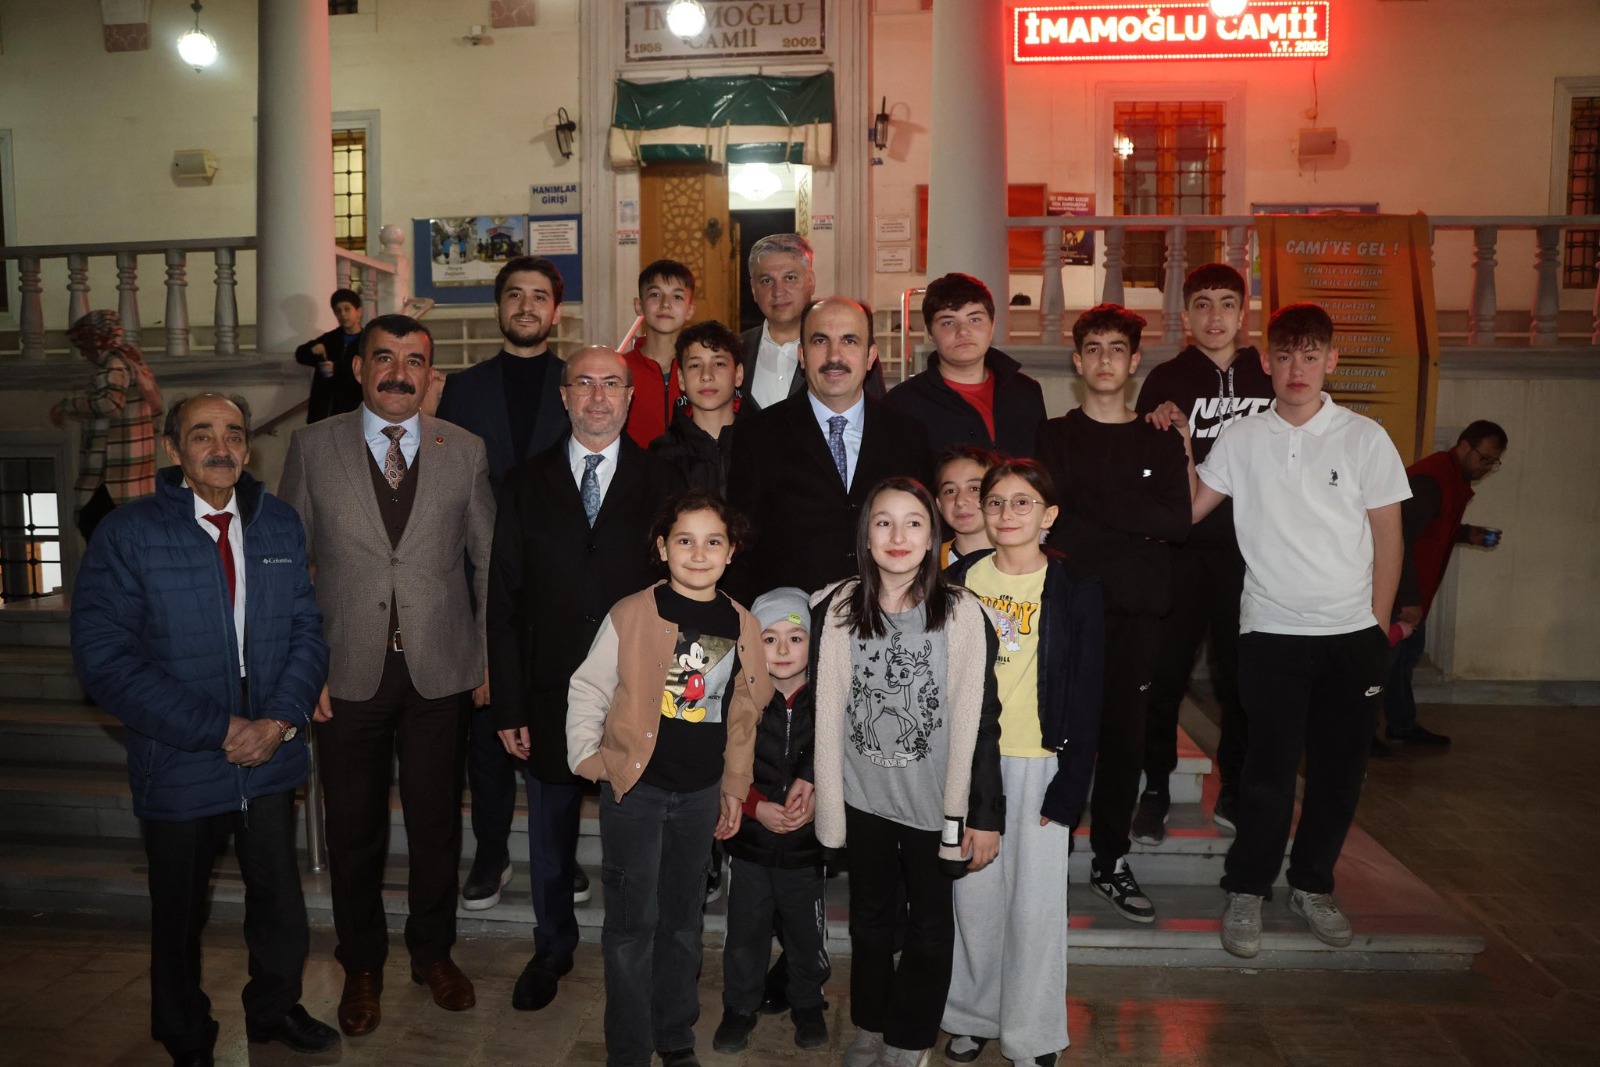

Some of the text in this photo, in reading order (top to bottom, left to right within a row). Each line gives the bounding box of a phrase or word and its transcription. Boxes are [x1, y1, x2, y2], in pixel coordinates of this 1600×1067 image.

[643, 3, 806, 31] İMMOĞLU
[1024, 7, 1318, 45] İMAMOĞLU CAMİİ
[633, 42, 662, 54] 1958
[782, 36, 818, 49] 2002
[1269, 40, 1327, 53] Y.T. 2002
[532, 185, 577, 194] HANIMLAR
[1286, 237, 1400, 257] CAMİ'YE GEL !
[1340, 368, 1387, 377] GELMEZSEN
